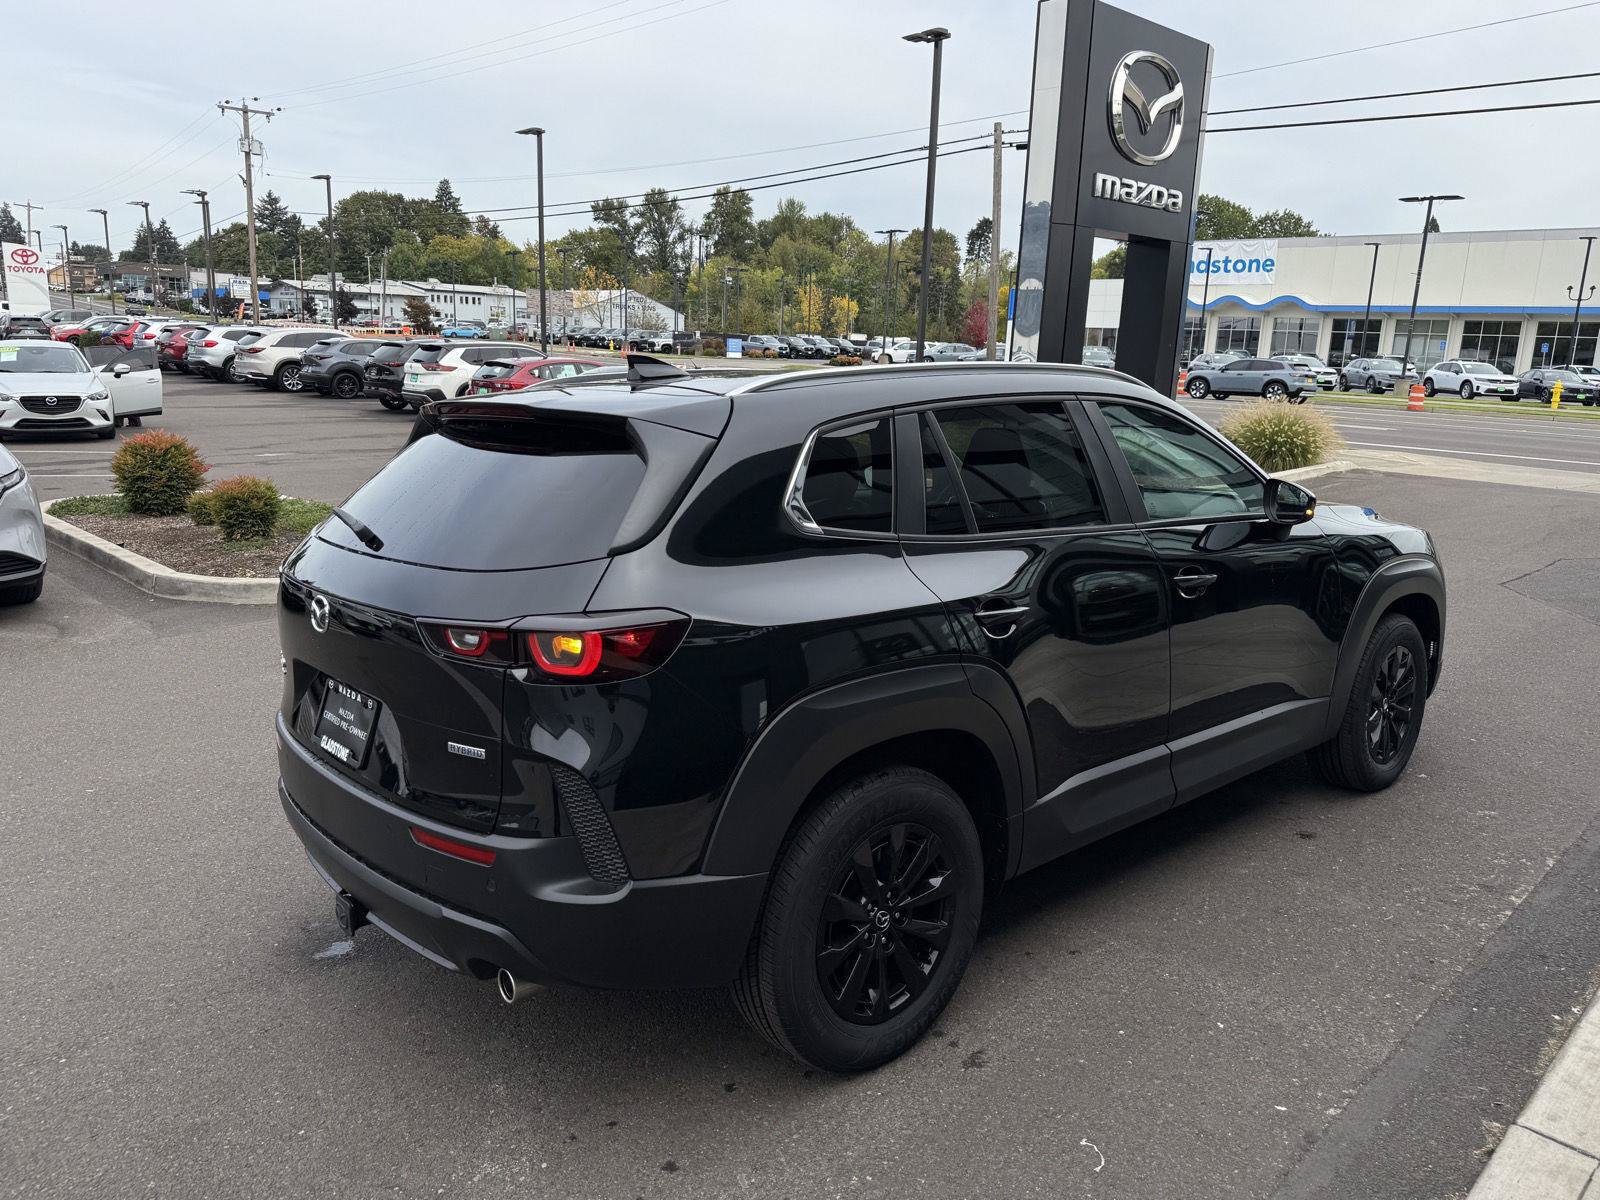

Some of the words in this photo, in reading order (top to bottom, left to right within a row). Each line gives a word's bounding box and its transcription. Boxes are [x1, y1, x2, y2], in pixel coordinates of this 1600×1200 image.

[7, 265, 46, 274] TOYOTA
[338, 684, 362, 703] MAZDA
[323, 710, 341, 726] CERTIFIED
[338, 707, 355, 722] MAZDA
[320, 735, 350, 762] GLADSTONE
[449, 743, 484, 758] HYBRID
